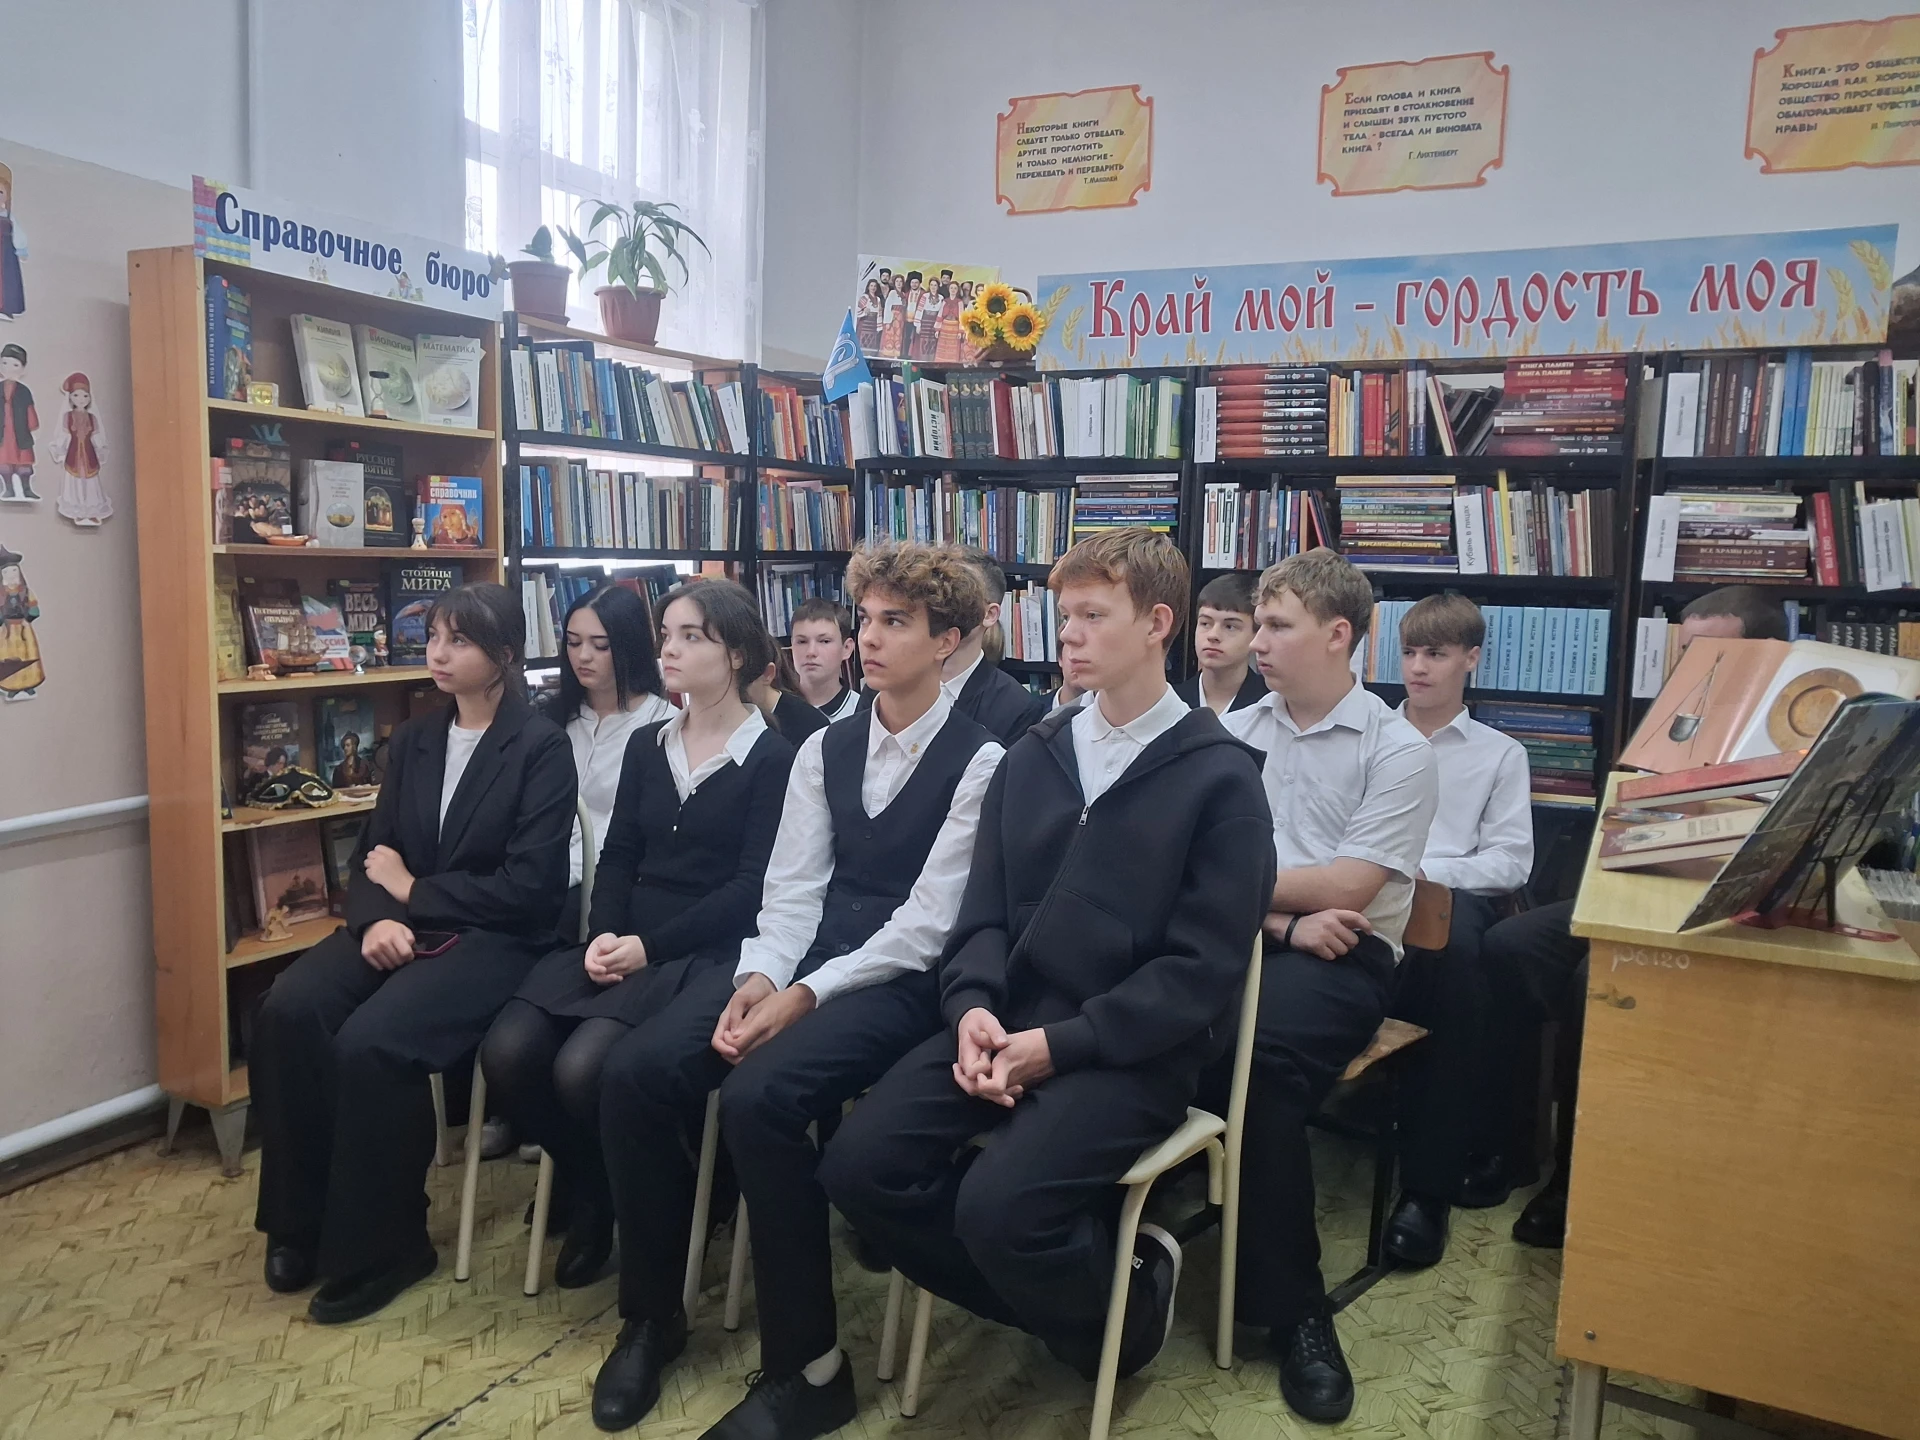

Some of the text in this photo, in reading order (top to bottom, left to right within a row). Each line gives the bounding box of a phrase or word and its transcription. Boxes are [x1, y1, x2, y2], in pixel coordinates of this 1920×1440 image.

[1780, 79, 1839, 92] ХОРОШАЯ
[1844, 76, 1867, 85] КАК
[1844, 84, 1920, 100] ПРОСВЕЩАЕ
[1376, 91, 1413, 102] ГОЛОВА
[1418, 89, 1425, 98] И
[1430, 86, 1461, 96] КНИГА
[1344, 97, 1475, 117] ПРИХОДЯТ В СТОЛКНОВЕНИЕ
[1876, 99, 1920, 111] ЧУВСТВ
[1072, 119, 1099, 129] КНИГИ
[1344, 111, 1467, 129] И СЛЫШЕН ЗВУК ПУСТОГО
[1344, 132, 1367, 141] ТЕЛА
[1379, 128, 1414, 139] ВСЕГДА
[1418, 127, 1432, 136] ЛИ
[1436, 123, 1482, 134] ВИНОВАТА
[1775, 123, 1818, 134] НРАВЫ
[1017, 136, 1048, 146] СЛЕДУЕТ
[1051, 133, 1080, 141] ТОЛЬКО
[1017, 143, 1103, 157] ДРУГИЕ ПРОГЛОТИТЬ
[1341, 144, 1372, 154] КНИГА
[1027, 159, 1057, 167] ТОЛЬКО
[1016, 169, 1065, 179] ПЕРЕЖЕВАТЬ
[1076, 164, 1124, 174] ПЕРЕВАРИТЬ
[215, 191, 490, 301] Справочное бюро
[1089, 274, 1212, 358] Край
[1234, 267, 1335, 332] мой
[1396, 268, 1660, 346] гордость
[1689, 258, 1819, 314] моя
[316, 324, 342, 337] ХИМИЯ
[369, 333, 412, 353] БИОЛОГИЯ
[422, 342, 476, 355] МАТЕМАТИКА
[355, 452, 396, 467] РУССКИЕ
[363, 462, 394, 477] ВЯТЫЕ
[401, 569, 452, 579] СТОЛИЦЫ
[401, 578, 452, 591] МИРА
[345, 593, 378, 612] ВЕСЬ
[347, 614, 377, 632] МИР
[324, 638, 347, 646] ССИЯ
[1526, 650, 1534, 673] Ближе
[1530, 616, 1538, 641] истине
[1484, 648, 1492, 670] Ближе
[1548, 651, 1556, 673] Ближе
[1570, 651, 1578, 674] Ближе
[1590, 652, 1598, 676] Ближе
